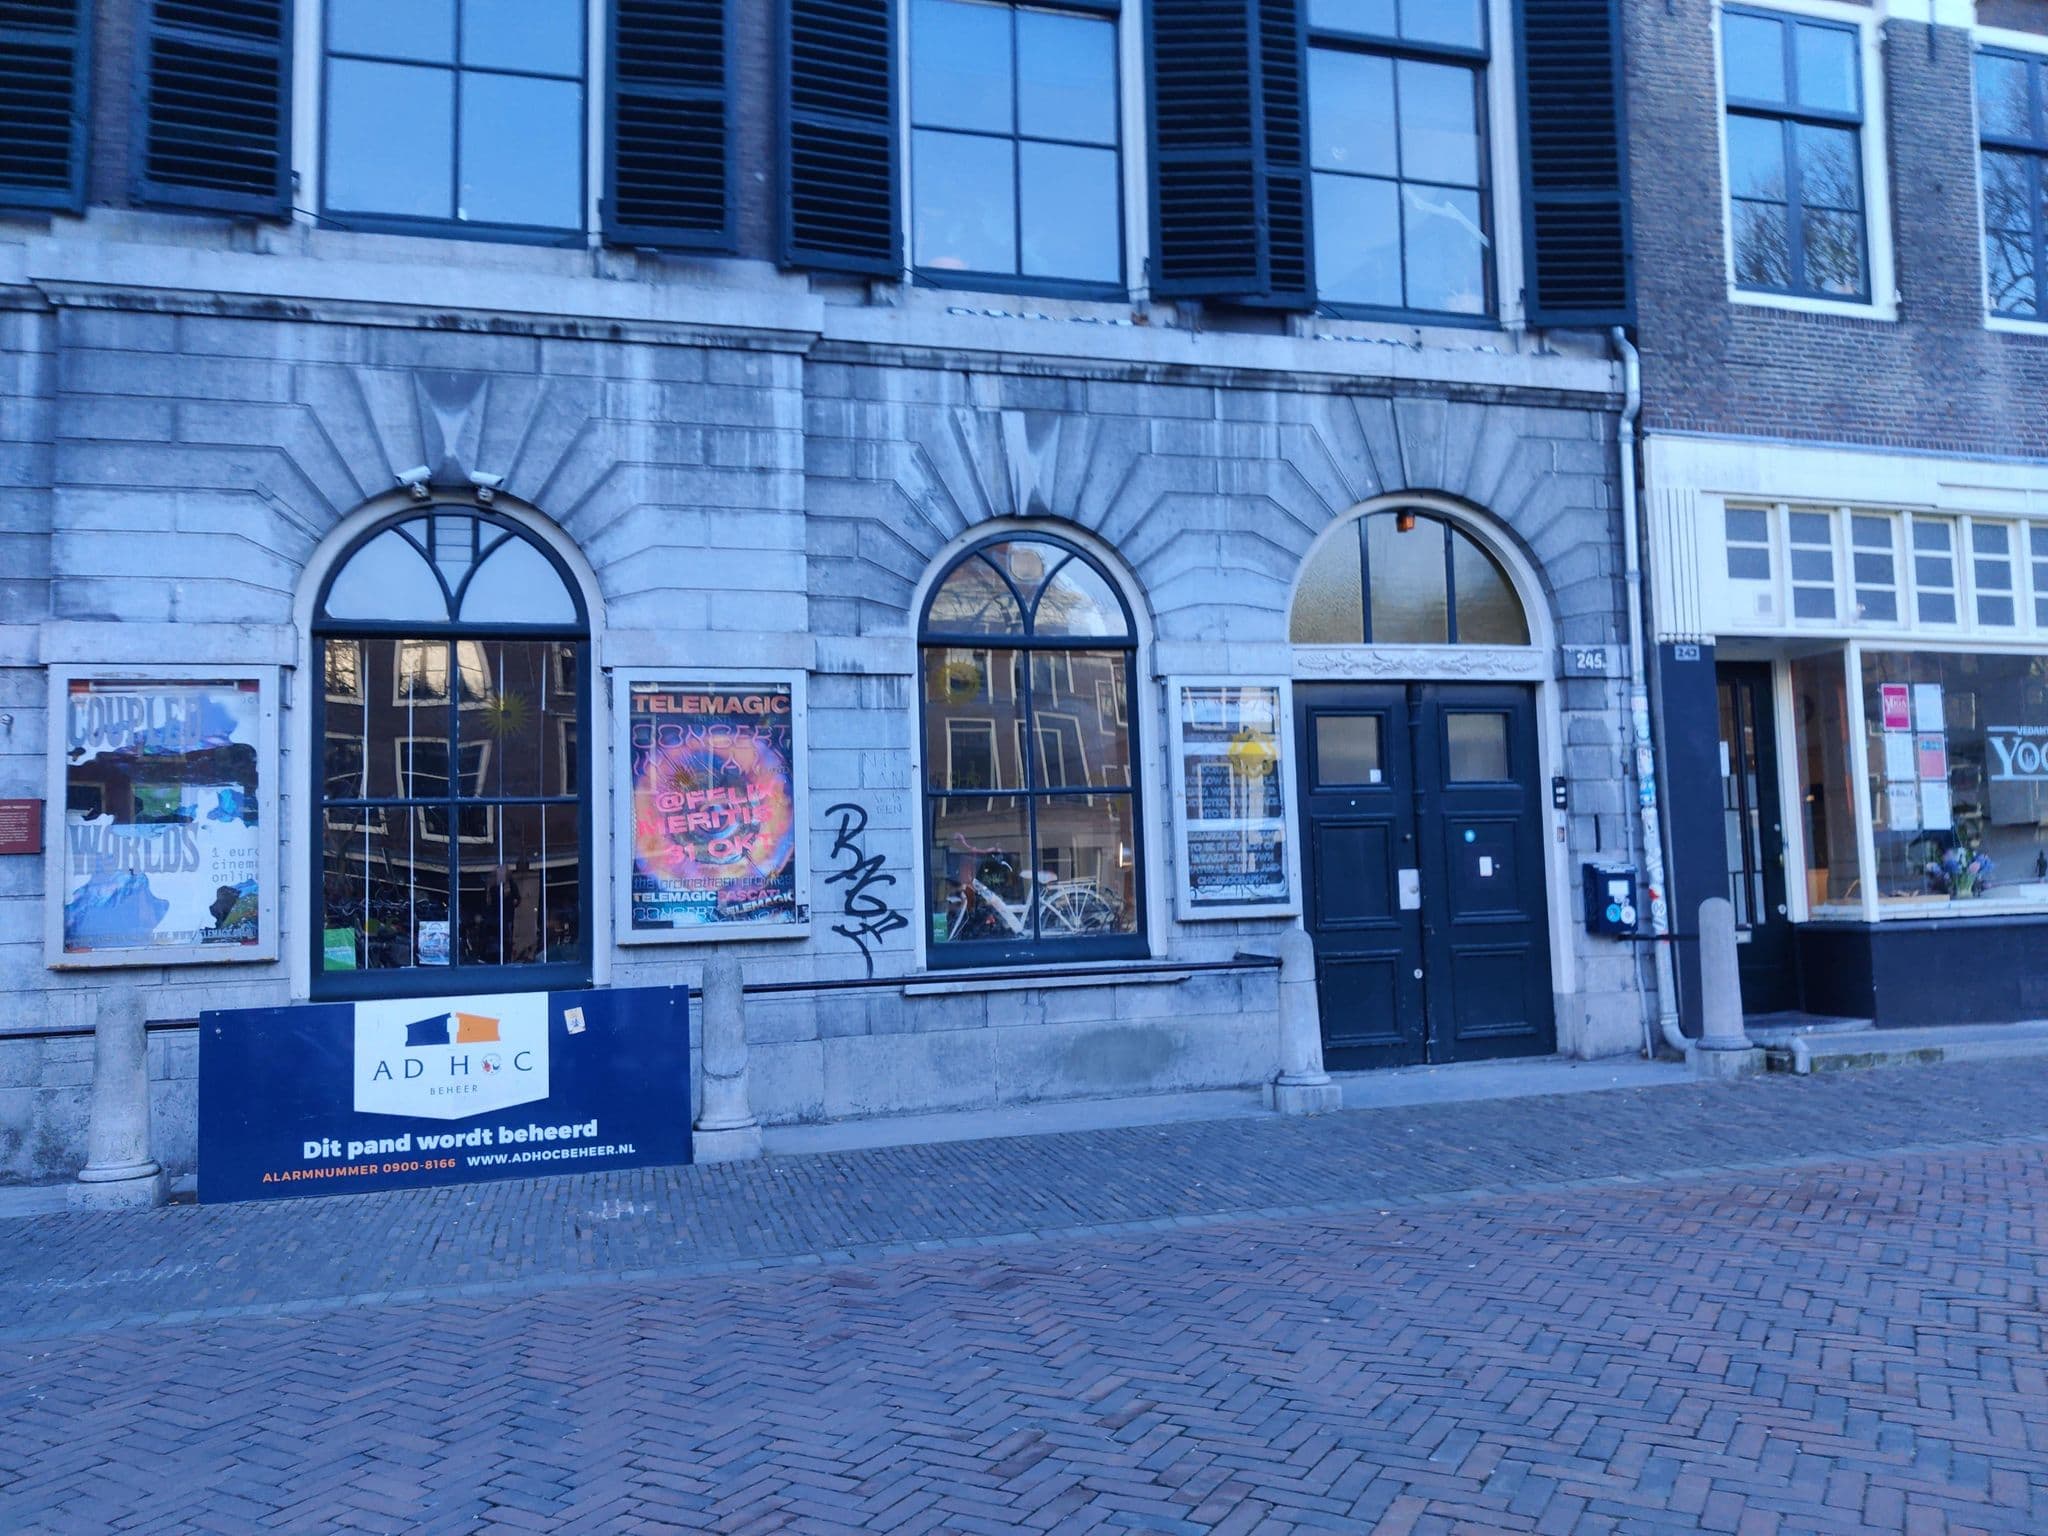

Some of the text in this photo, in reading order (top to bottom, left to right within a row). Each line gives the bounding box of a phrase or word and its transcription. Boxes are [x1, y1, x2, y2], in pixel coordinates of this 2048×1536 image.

[632, 695, 790, 714] TELEMAGIC
[632, 724, 791, 749] CONCERT
[639, 804, 774, 836] MERITIS
[69, 823, 200, 876] WORLDS
[633, 891, 717, 903] TELEMAGIC
[373, 1058, 424, 1081] AD
[430, 1084, 479, 1096] BEHEER
[303, 1118, 598, 1160] Dit pand wordt beheerd
[466, 1143, 636, 1167] WWW.ADHOCBEHEER.NL
[262, 1158, 456, 1183] ALARMNUMMER 0900-8166
